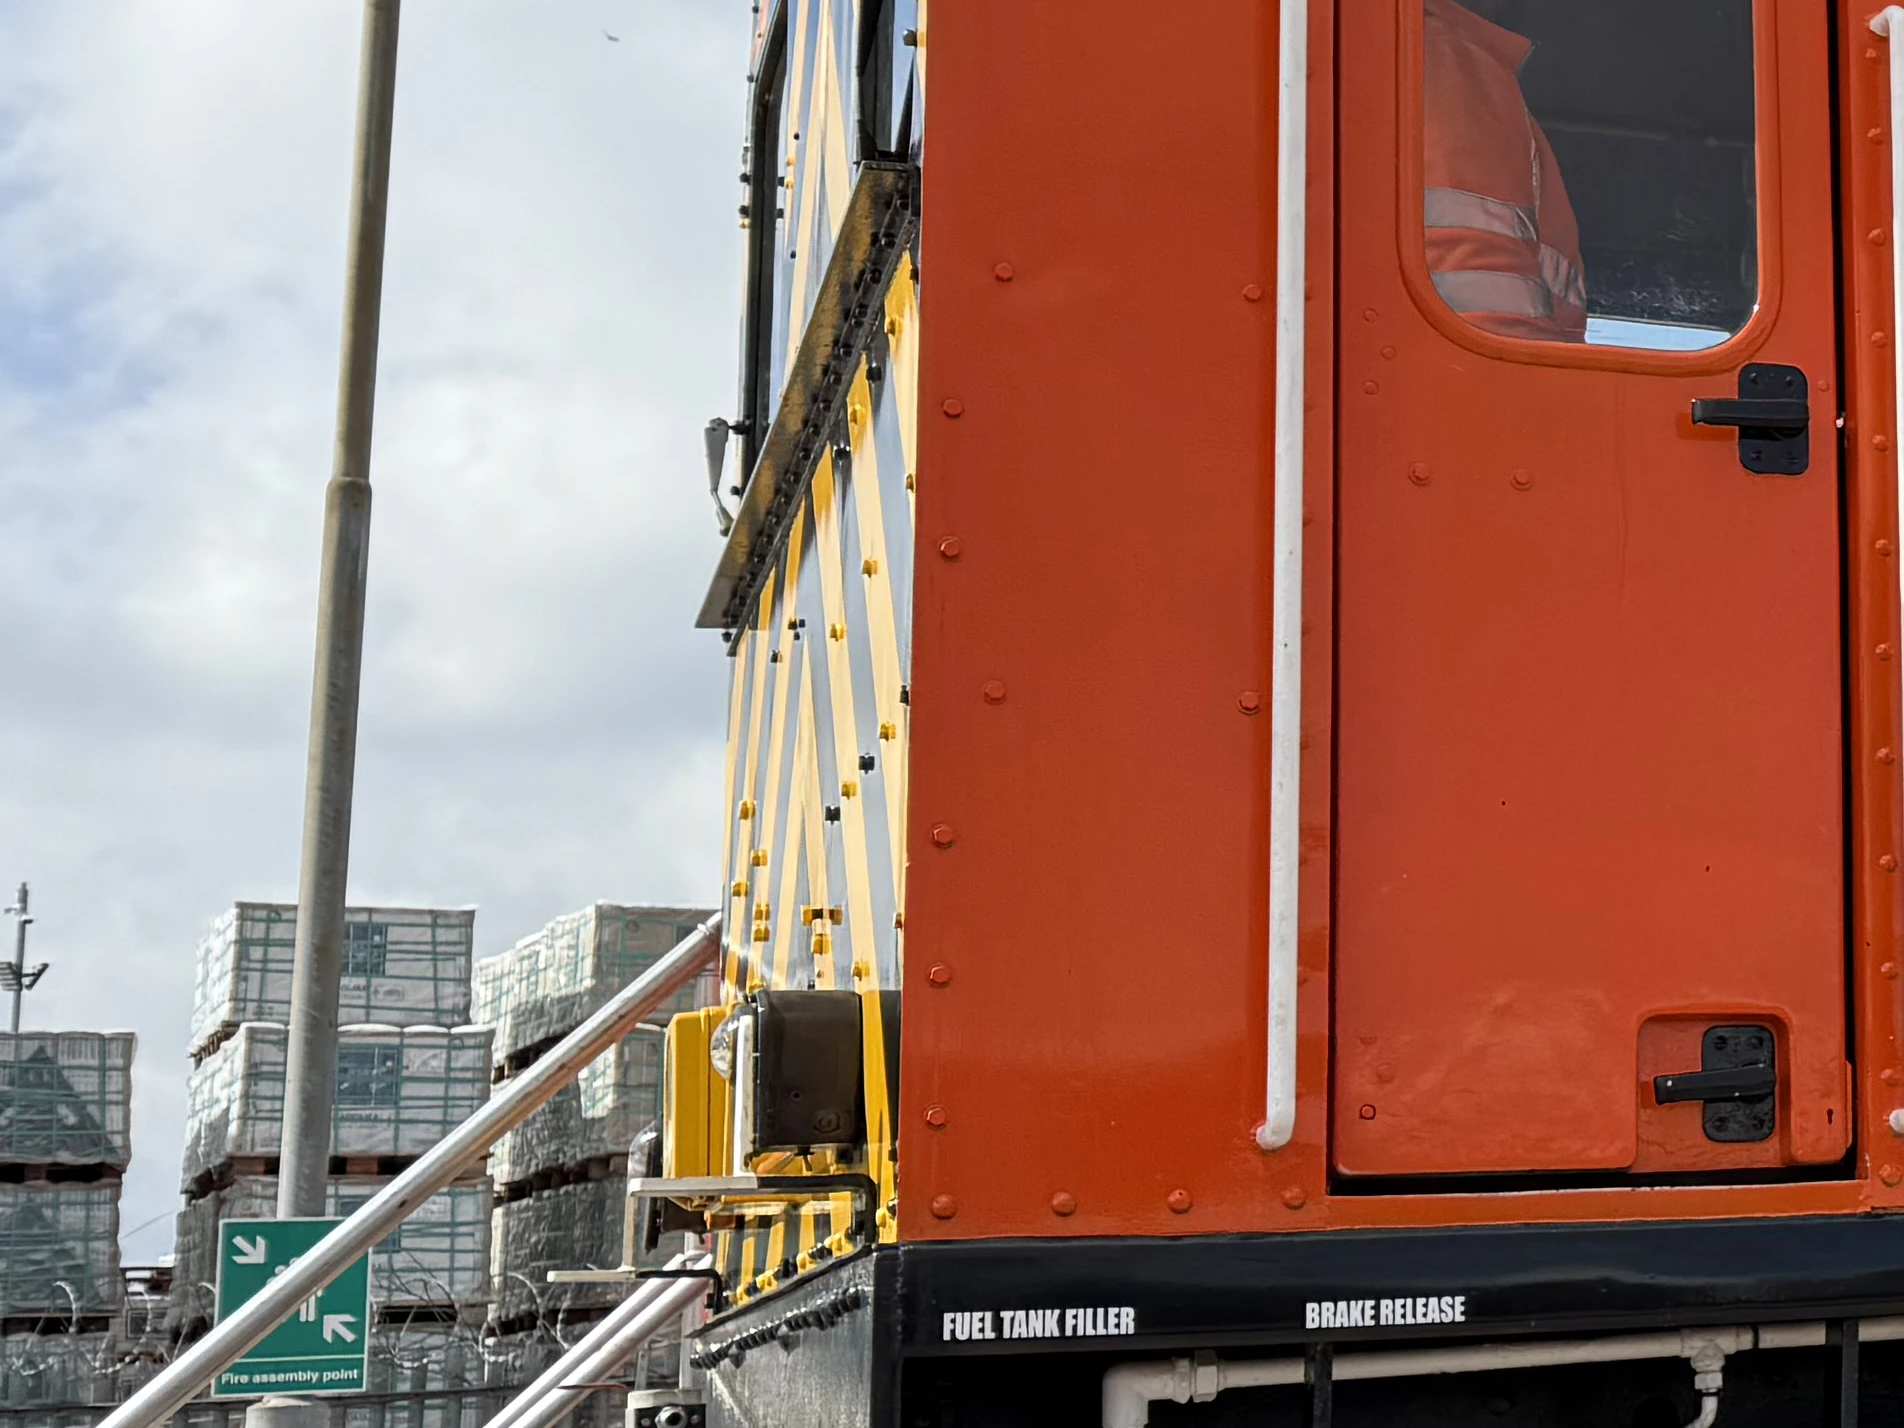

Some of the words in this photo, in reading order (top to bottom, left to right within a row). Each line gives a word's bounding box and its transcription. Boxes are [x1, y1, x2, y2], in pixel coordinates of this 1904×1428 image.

[943, 1312, 995, 1341] FUEL
[999, 1309, 1060, 1339] TANK
[1064, 1307, 1135, 1337] FILLER
[1305, 1298, 1376, 1330] BRAKE
[1380, 1295, 1466, 1327] RELEASE
[221, 1373, 249, 1385] Fire
[252, 1370, 319, 1384] assembly
[323, 1368, 358, 1382] point
